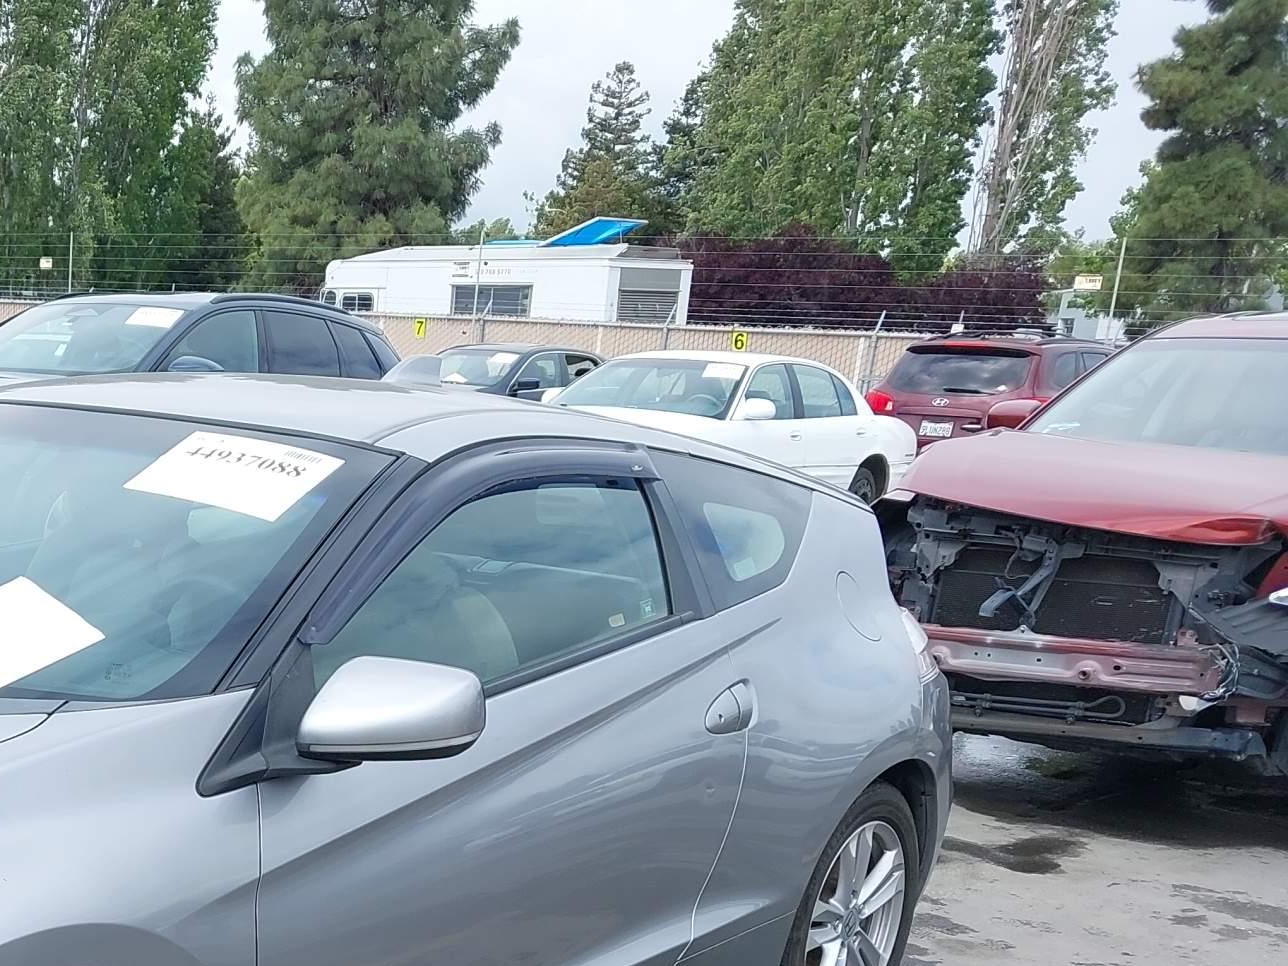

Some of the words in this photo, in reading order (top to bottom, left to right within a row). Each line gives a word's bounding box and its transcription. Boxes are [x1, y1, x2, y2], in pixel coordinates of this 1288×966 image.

[416, 320, 424, 335] 7
[734, 333, 745, 350] 6
[186, 446, 308, 478] 44937088
